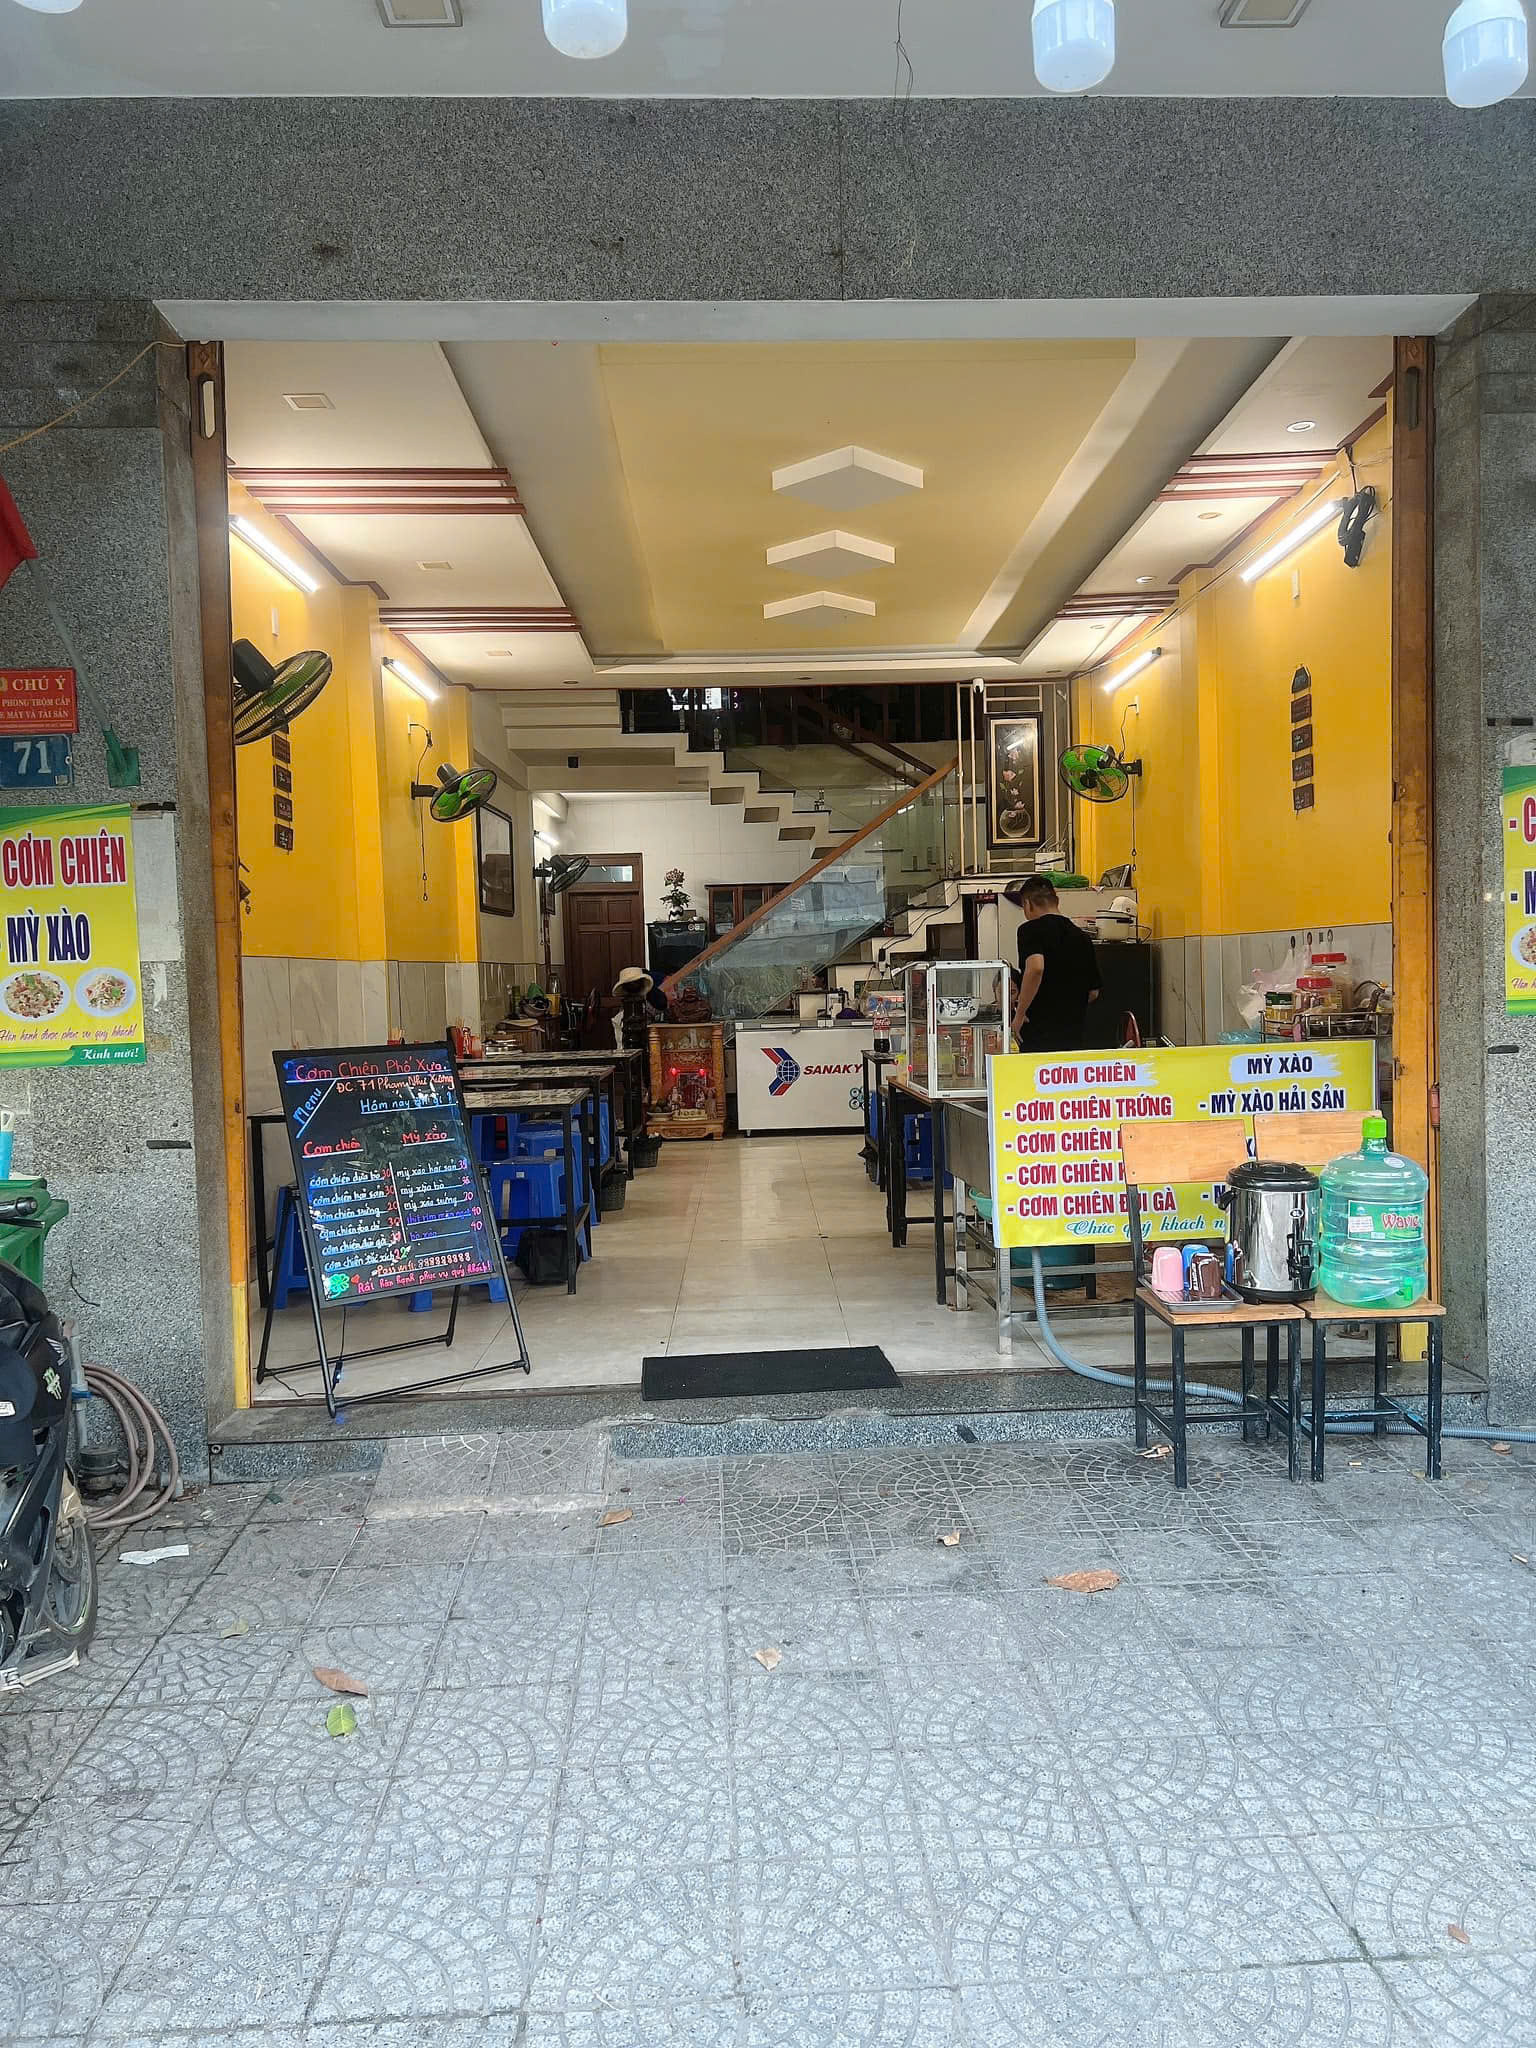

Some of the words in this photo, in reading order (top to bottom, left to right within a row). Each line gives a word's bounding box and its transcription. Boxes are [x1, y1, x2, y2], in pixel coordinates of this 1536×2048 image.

[12, 675, 48, 690] CHÚ
[56, 674, 66, 690] Ý
[14, 741, 52, 774] 71
[2, 833, 54, 886] CƠM
[60, 829, 126, 884] CHIÊN
[7, 909, 40, 962] MỲ
[46, 908, 90, 961] XÀO
[386, 1056, 412, 1074] Phố
[804, 1064, 863, 1076] SANAKY
[1040, 1066, 1078, 1085] CƠM
[1084, 1062, 1136, 1083] CHIÊN
[1248, 1054, 1273, 1074] MỲ
[1278, 1054, 1312, 1073] XÀO
[357, 1080, 374, 1092] 71
[1211, 1090, 1236, 1114] MỲ
[1241, 1088, 1274, 1112] XÀO
[1279, 1085, 1306, 1110] HẢI
[1311, 1084, 1344, 1109] SẢN
[292, 1087, 322, 1124] Menu
[1016, 1099, 1054, 1122] CƠM
[1060, 1096, 1111, 1120] CHIÊN
[1116, 1094, 1172, 1117] TRỨNG
[1018, 1132, 1055, 1154] CƠM
[1061, 1128, 1112, 1152] CHIÊN
[1018, 1164, 1056, 1186] CƠM
[1062, 1159, 1113, 1183] CHIÊN
[1020, 1196, 1058, 1216] CƠM
[1064, 1190, 1114, 1215] CHIÊN
[1154, 1187, 1176, 1212] GÀ
[1066, 1219, 1115, 1236] Chúc
[1160, 1215, 1205, 1232] khách
